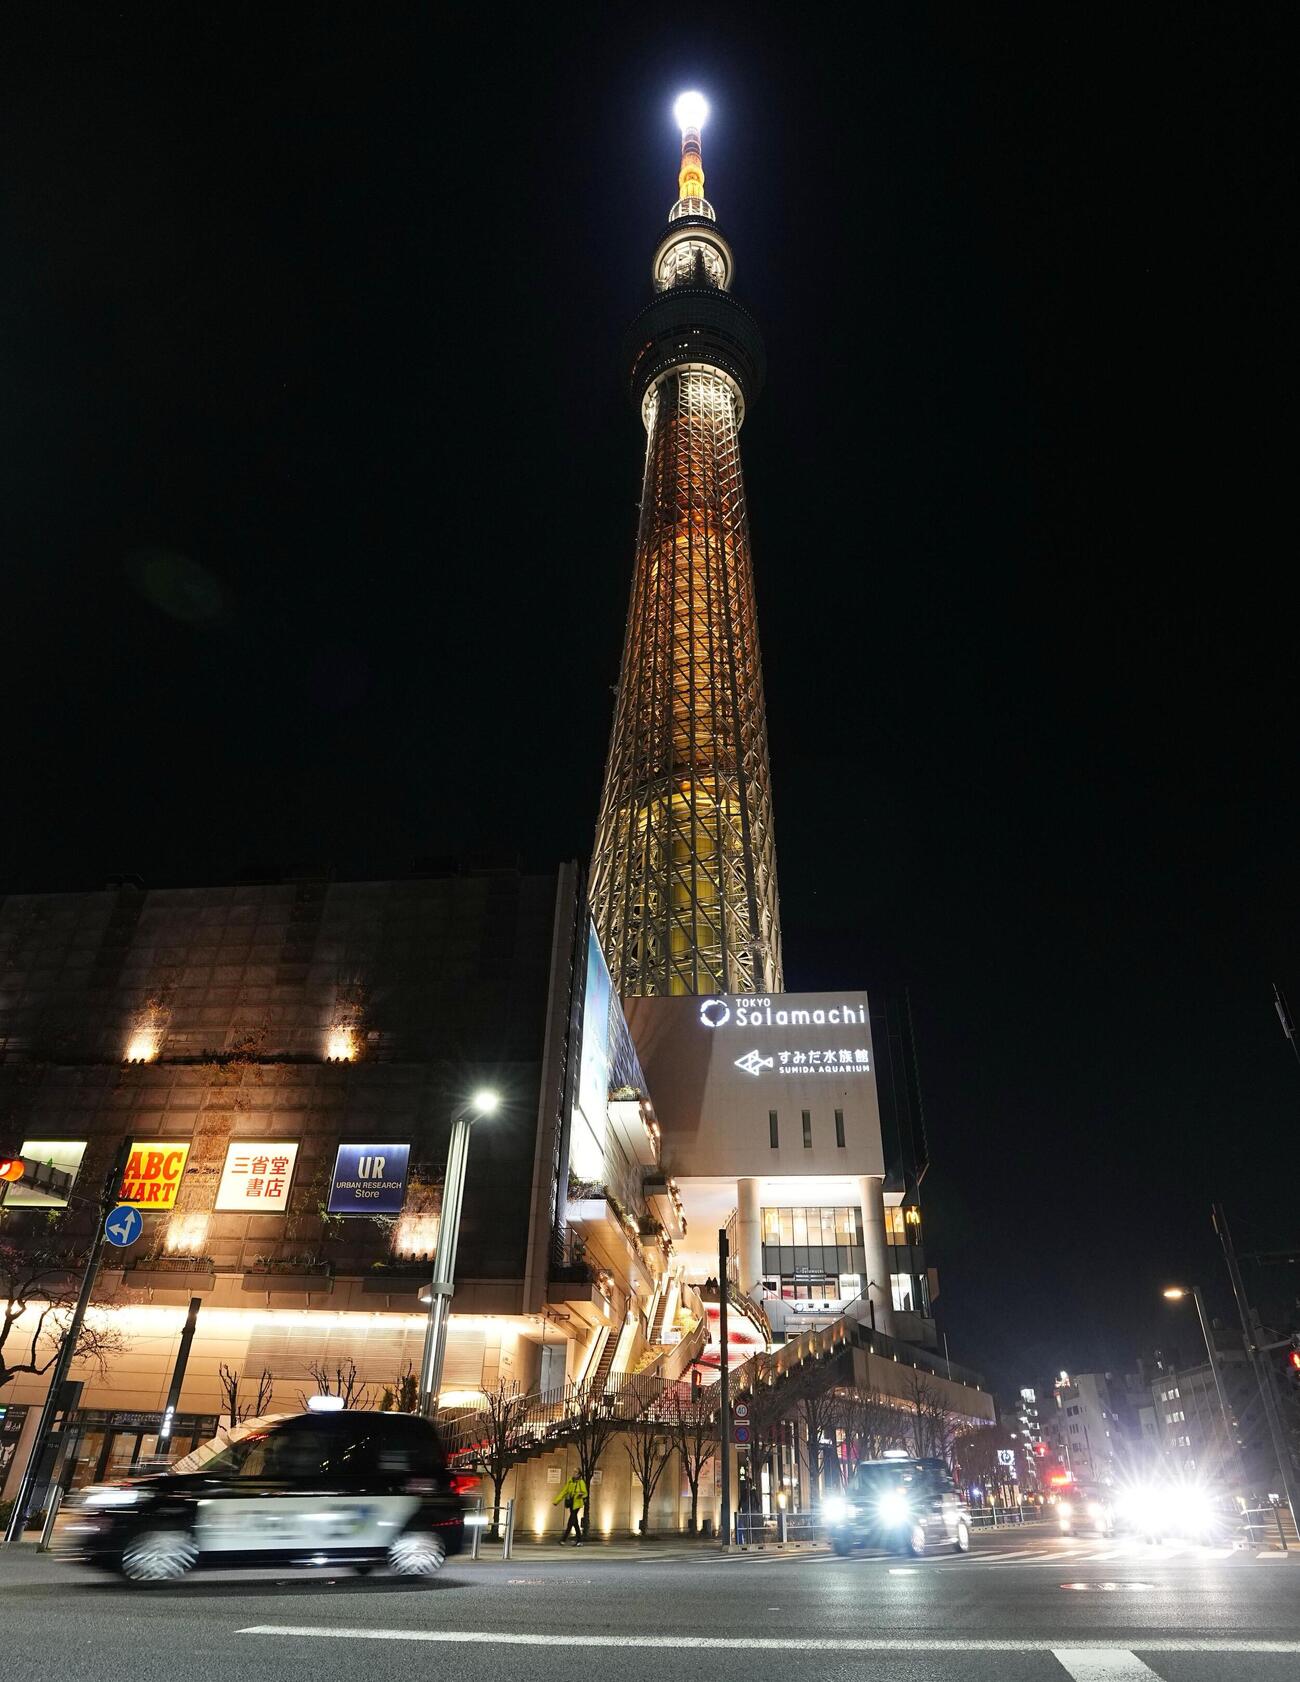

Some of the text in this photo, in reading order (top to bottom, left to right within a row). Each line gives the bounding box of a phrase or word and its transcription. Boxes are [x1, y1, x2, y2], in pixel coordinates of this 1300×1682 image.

[736, 998, 771, 1008] TOKYO
[735, 1005, 865, 1027] Solamachi
[778, 1049, 869, 1065] すみだ水族館
[779, 1065, 870, 1074] SUMIDA AQUARIUM
[123, 1151, 184, 1181] ABC
[231, 1155, 289, 1175] 三省堂
[358, 1156, 386, 1179] UR
[118, 1183, 176, 1202] MART
[246, 1178, 285, 1197] 書店
[336, 1181, 402, 1189] URBAN RESEARCH
[354, 1188, 380, 1198] Store
